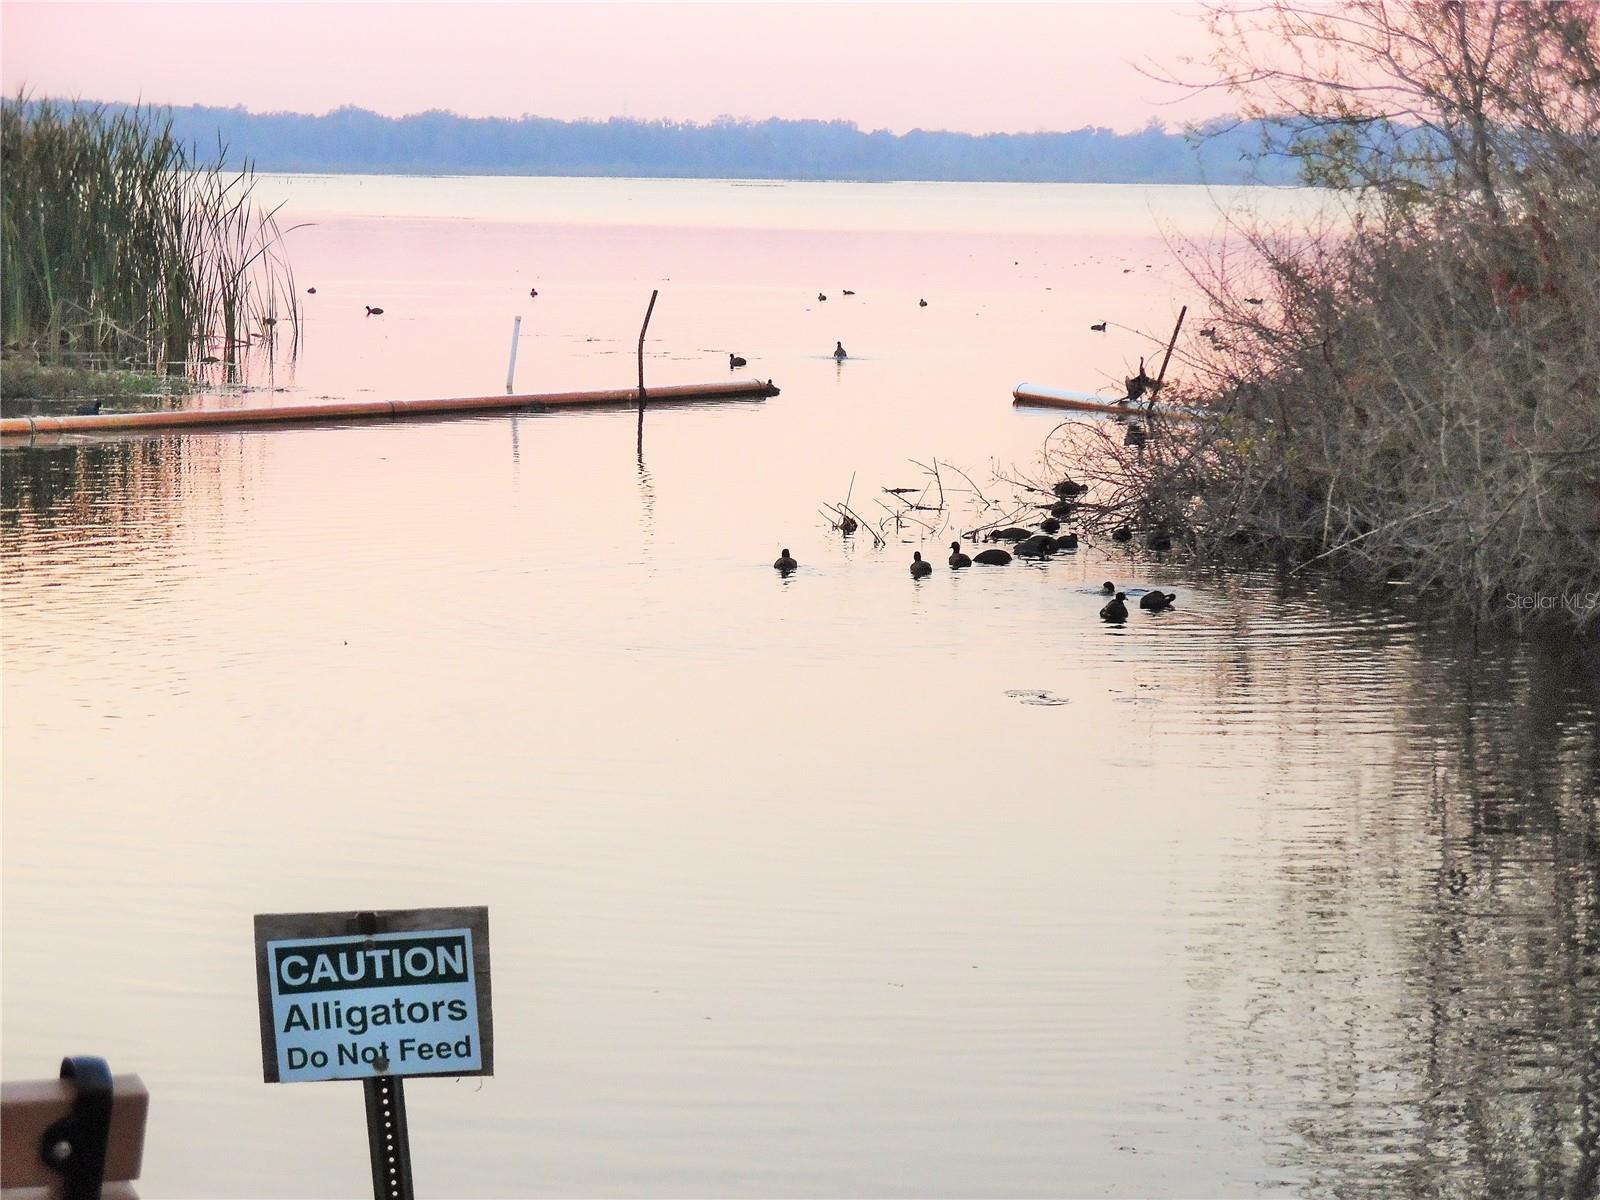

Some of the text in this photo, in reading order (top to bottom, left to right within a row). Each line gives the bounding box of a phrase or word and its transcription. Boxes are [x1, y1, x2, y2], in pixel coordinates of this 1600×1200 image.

[280, 945, 464, 986] CAUTION
[283, 998, 468, 1035] Alligators
[287, 1035, 472, 1070] Do Not Feed
